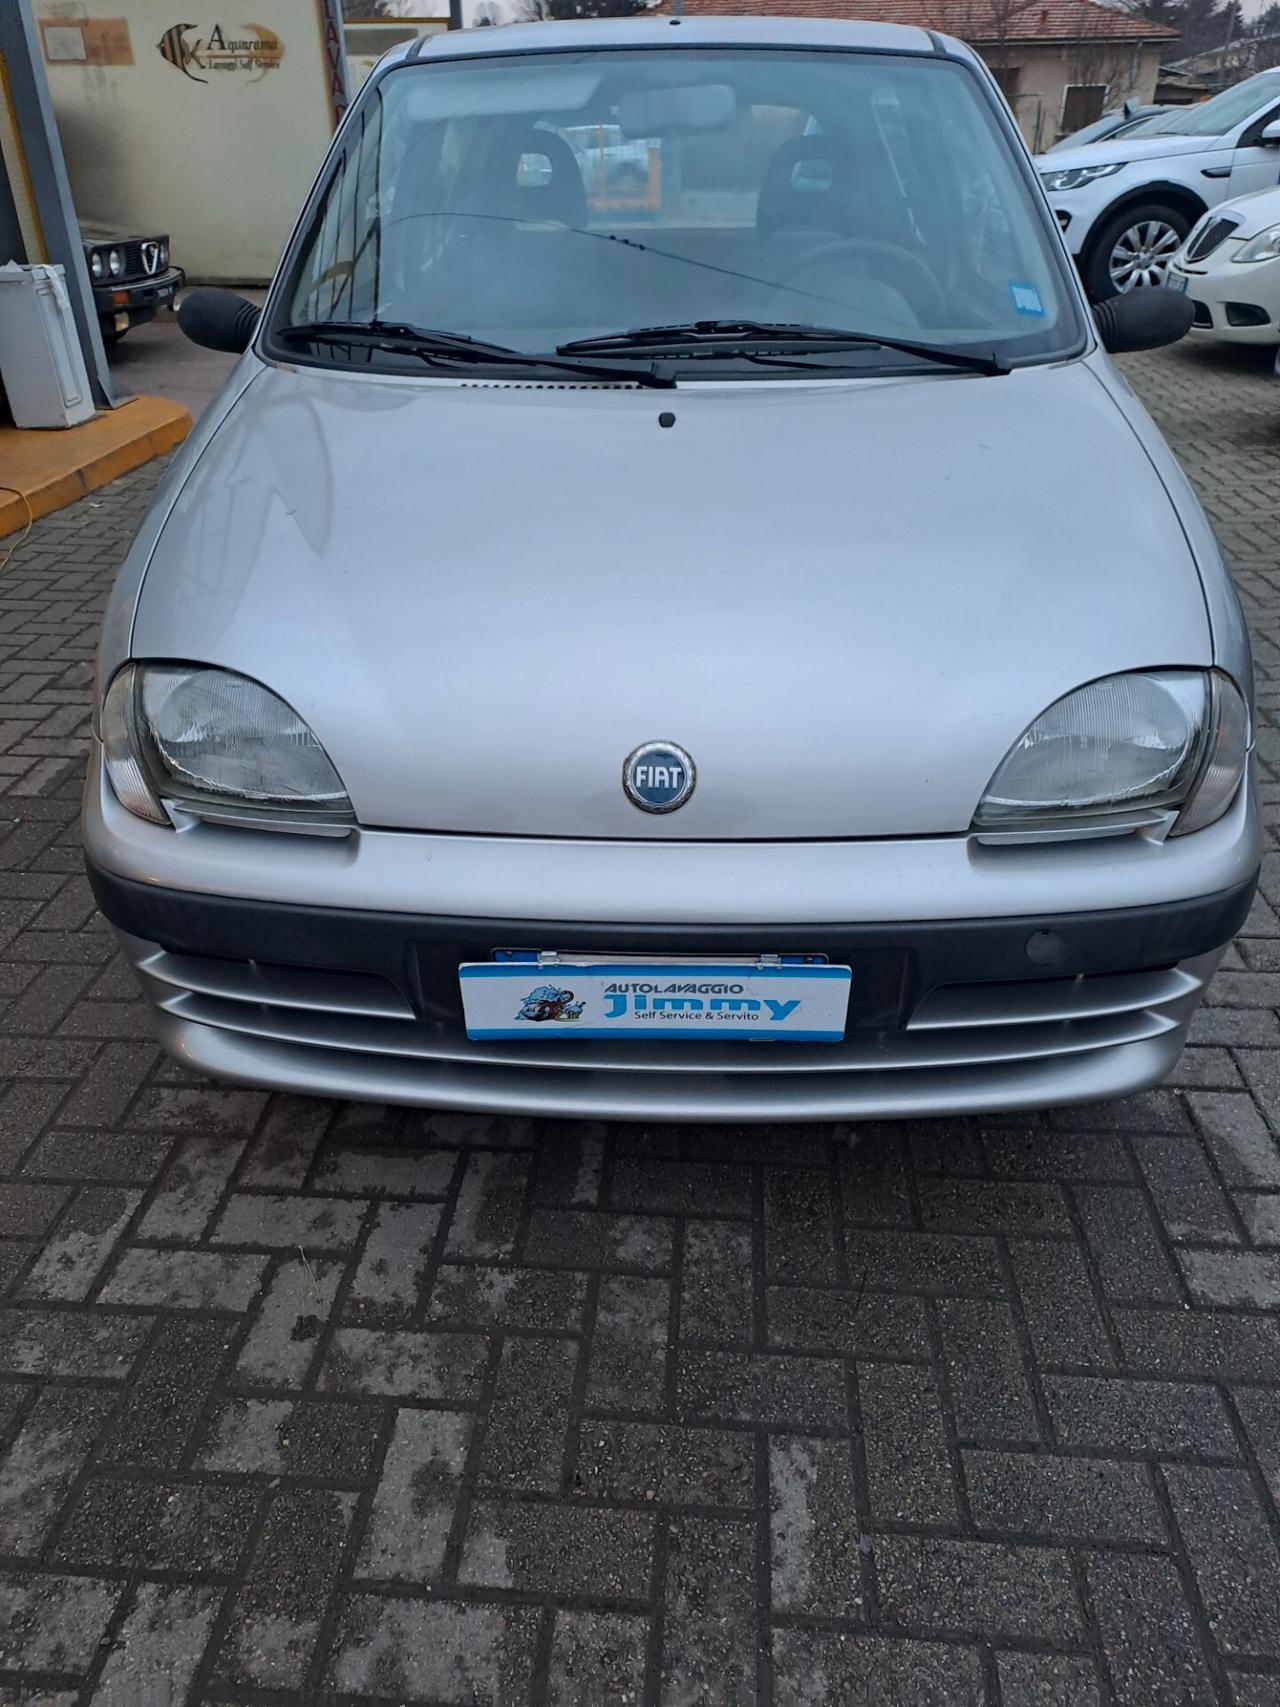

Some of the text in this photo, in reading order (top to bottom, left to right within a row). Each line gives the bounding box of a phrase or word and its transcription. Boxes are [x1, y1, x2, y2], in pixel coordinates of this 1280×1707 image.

[206, 23, 278, 53] Aquarama
[240, 59, 253, 71] Self
[255, 59, 281, 69] Service
[636, 766, 681, 788] FIAT
[604, 983, 744, 994] AUTOLAVAGGIO
[603, 994, 801, 1021] Jimmy
[634, 1011, 759, 1021] Self Service & Servito
